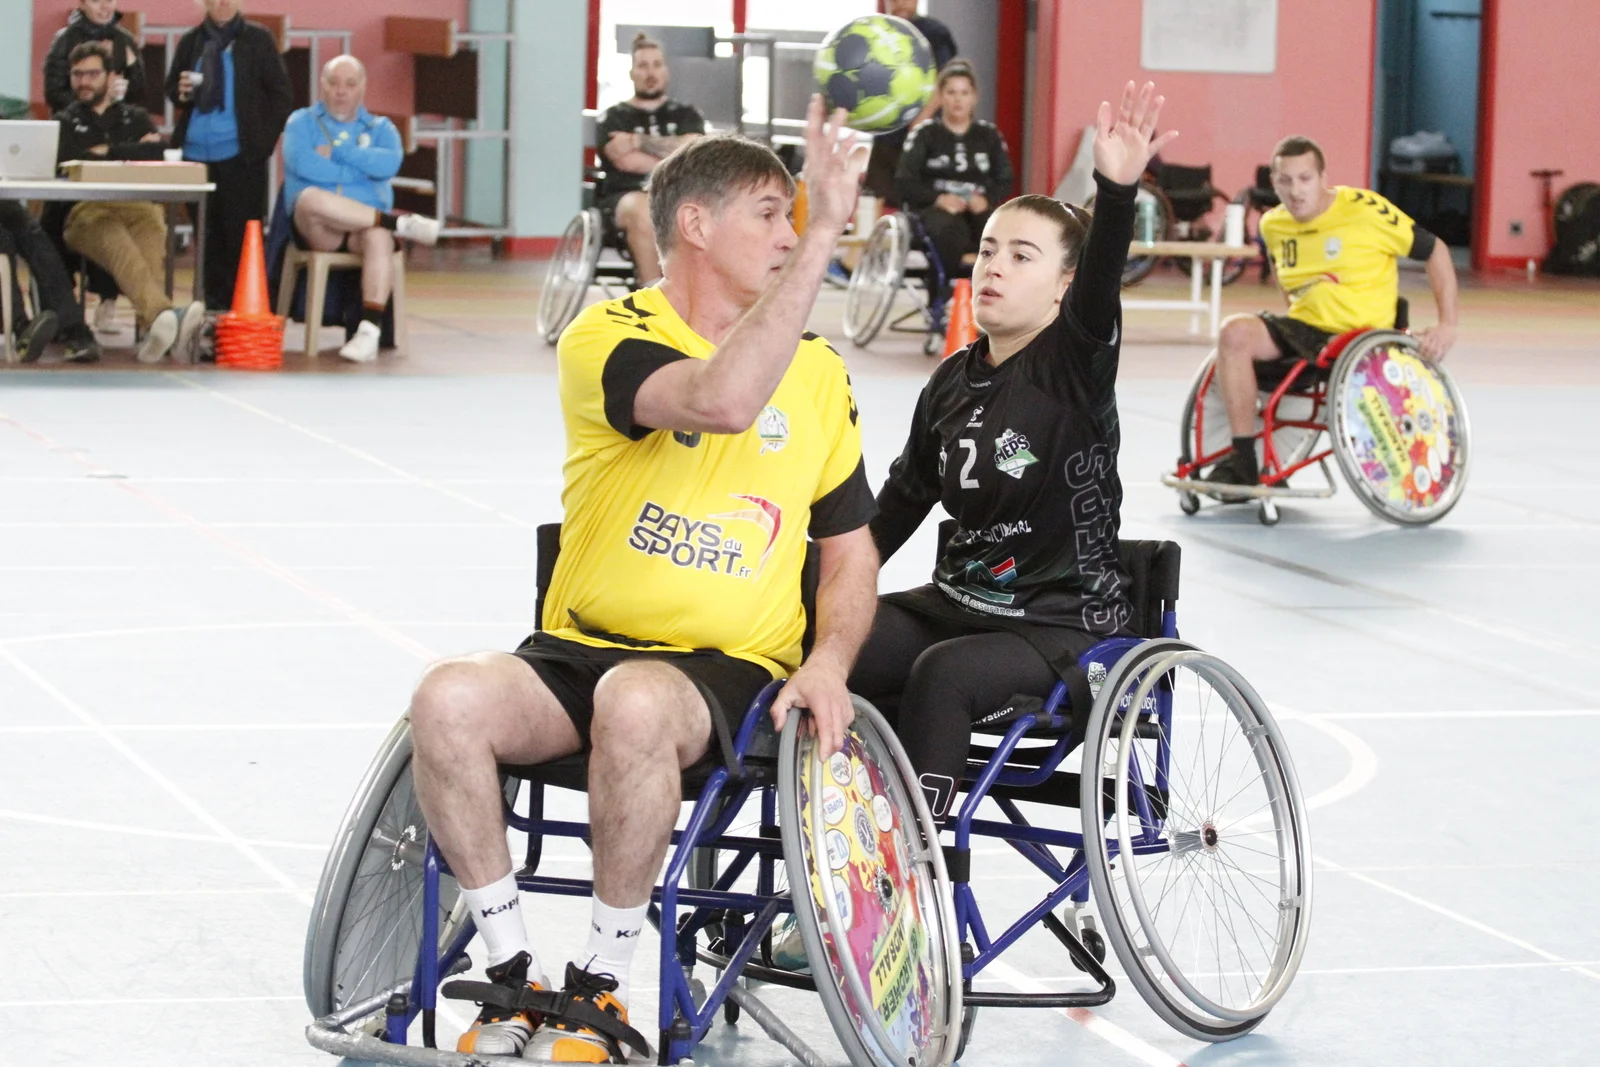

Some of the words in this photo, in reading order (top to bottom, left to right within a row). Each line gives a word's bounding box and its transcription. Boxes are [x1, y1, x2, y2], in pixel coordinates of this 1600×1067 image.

[1281, 238, 1298, 268] 10
[959, 438, 980, 489] 2
[637, 501, 722, 548] PAYS
[724, 539, 742, 551] du
[969, 599, 1026, 617] assurances
